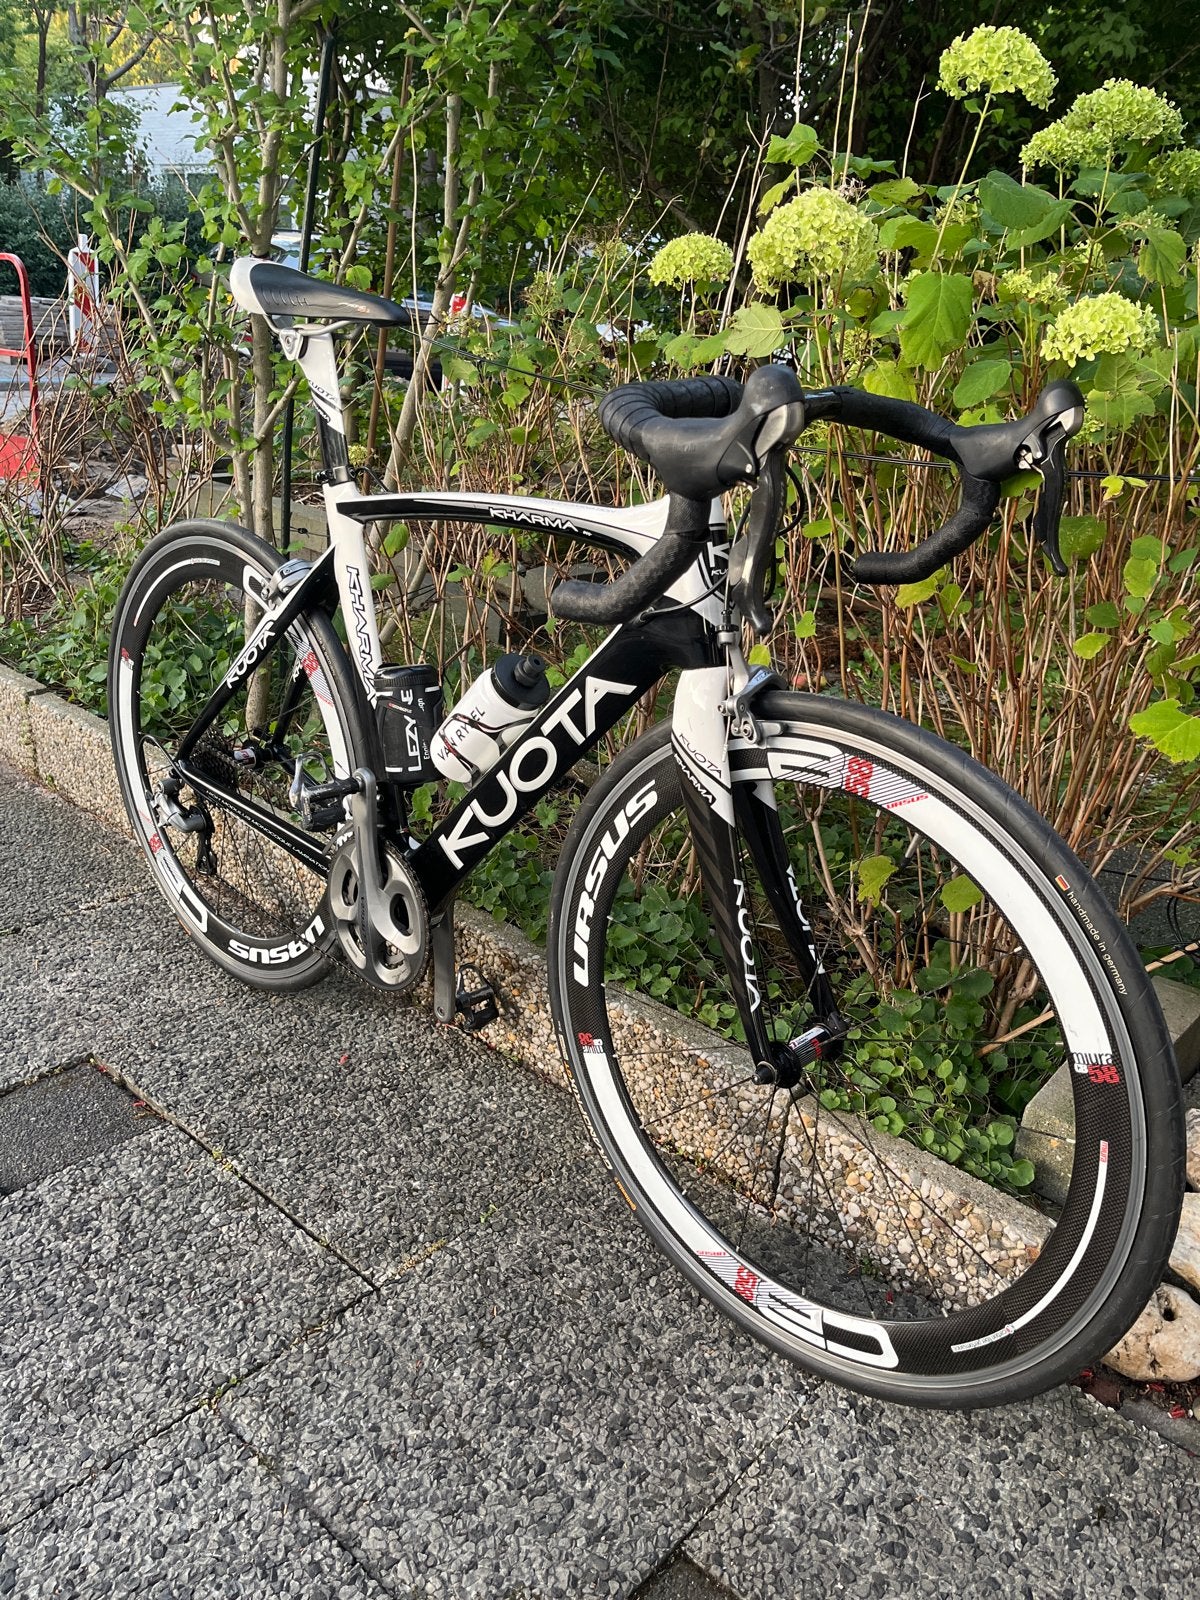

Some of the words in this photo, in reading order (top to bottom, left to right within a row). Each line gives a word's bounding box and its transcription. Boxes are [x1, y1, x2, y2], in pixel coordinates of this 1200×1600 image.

[489, 507, 578, 532] KHARMA
[226, 630, 276, 689] KUOTA
[346, 565, 378, 708] KHARMA
[455, 706, 486, 742] RYEL
[438, 675, 638, 870] KUOTA
[674, 753, 713, 803] KHARMA
[679, 733, 722, 779] KUOTA
[573, 779, 659, 988] URSUS
[228, 914, 325, 964] URSUS
[1066, 891, 1100, 941] handmade
[1098, 941, 1108, 953] in
[1102, 952, 1128, 996] germany
[1073, 1051, 1113, 1067] miura
[1088, 1064, 1120, 1084] 58
